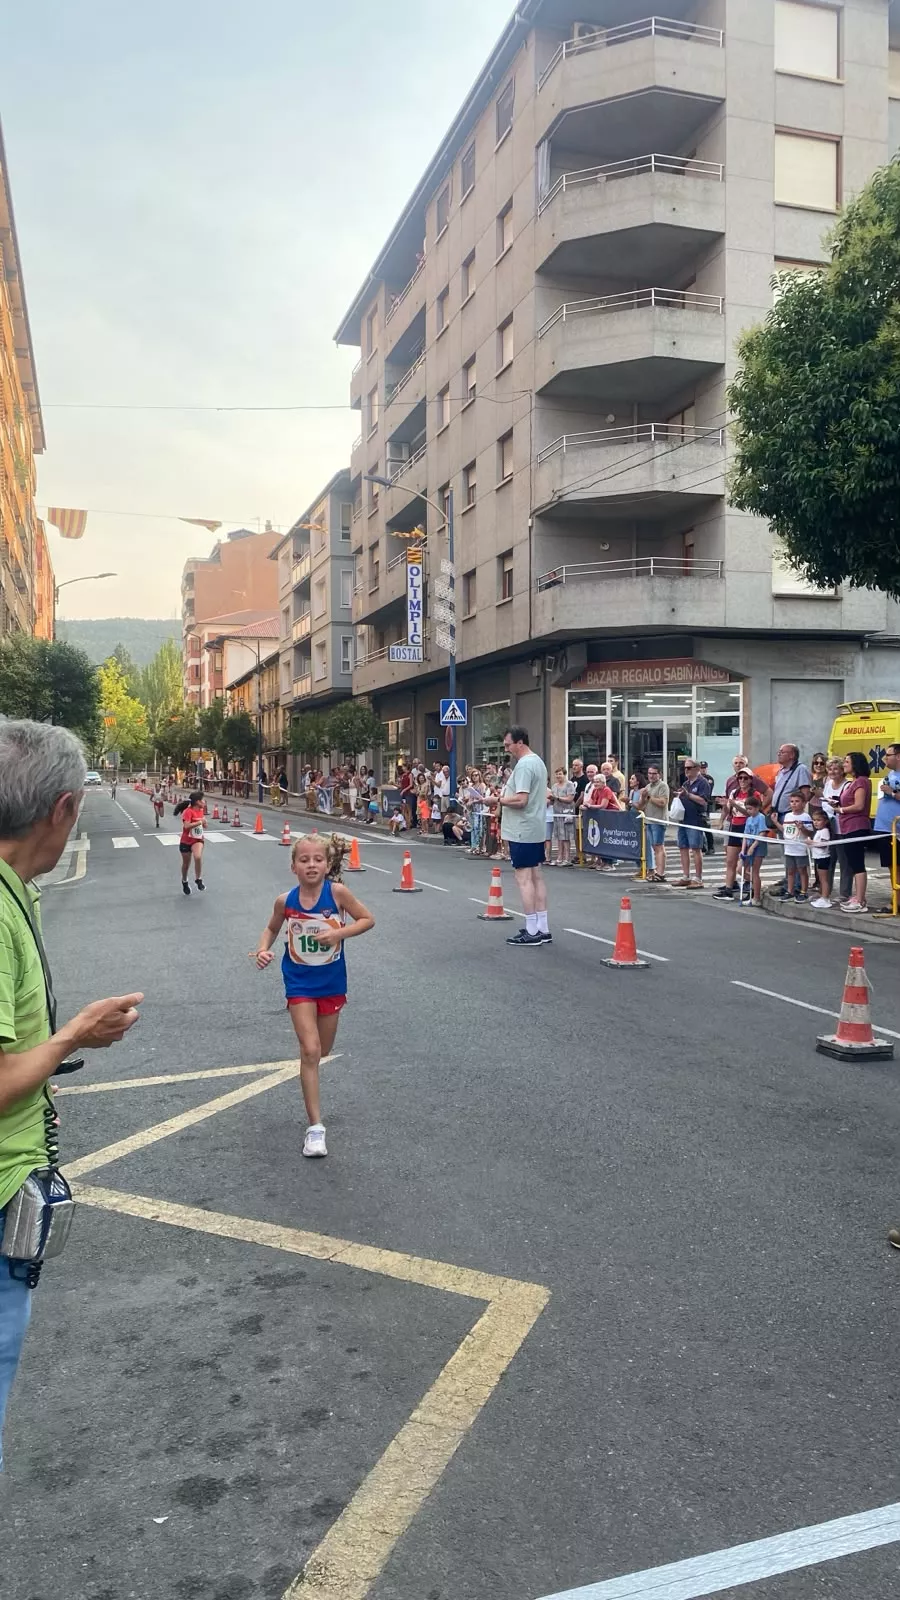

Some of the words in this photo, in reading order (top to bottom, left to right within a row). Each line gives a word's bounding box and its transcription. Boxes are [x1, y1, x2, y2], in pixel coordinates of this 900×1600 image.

[409, 566, 421, 644] OLIMPIC
[391, 648, 421, 660] HOSTAL
[587, 670, 619, 685] BAZAR
[622, 667, 661, 683] REGALO
[843, 725, 886, 735] AMBULANCIA
[785, 826, 796, 834] 151
